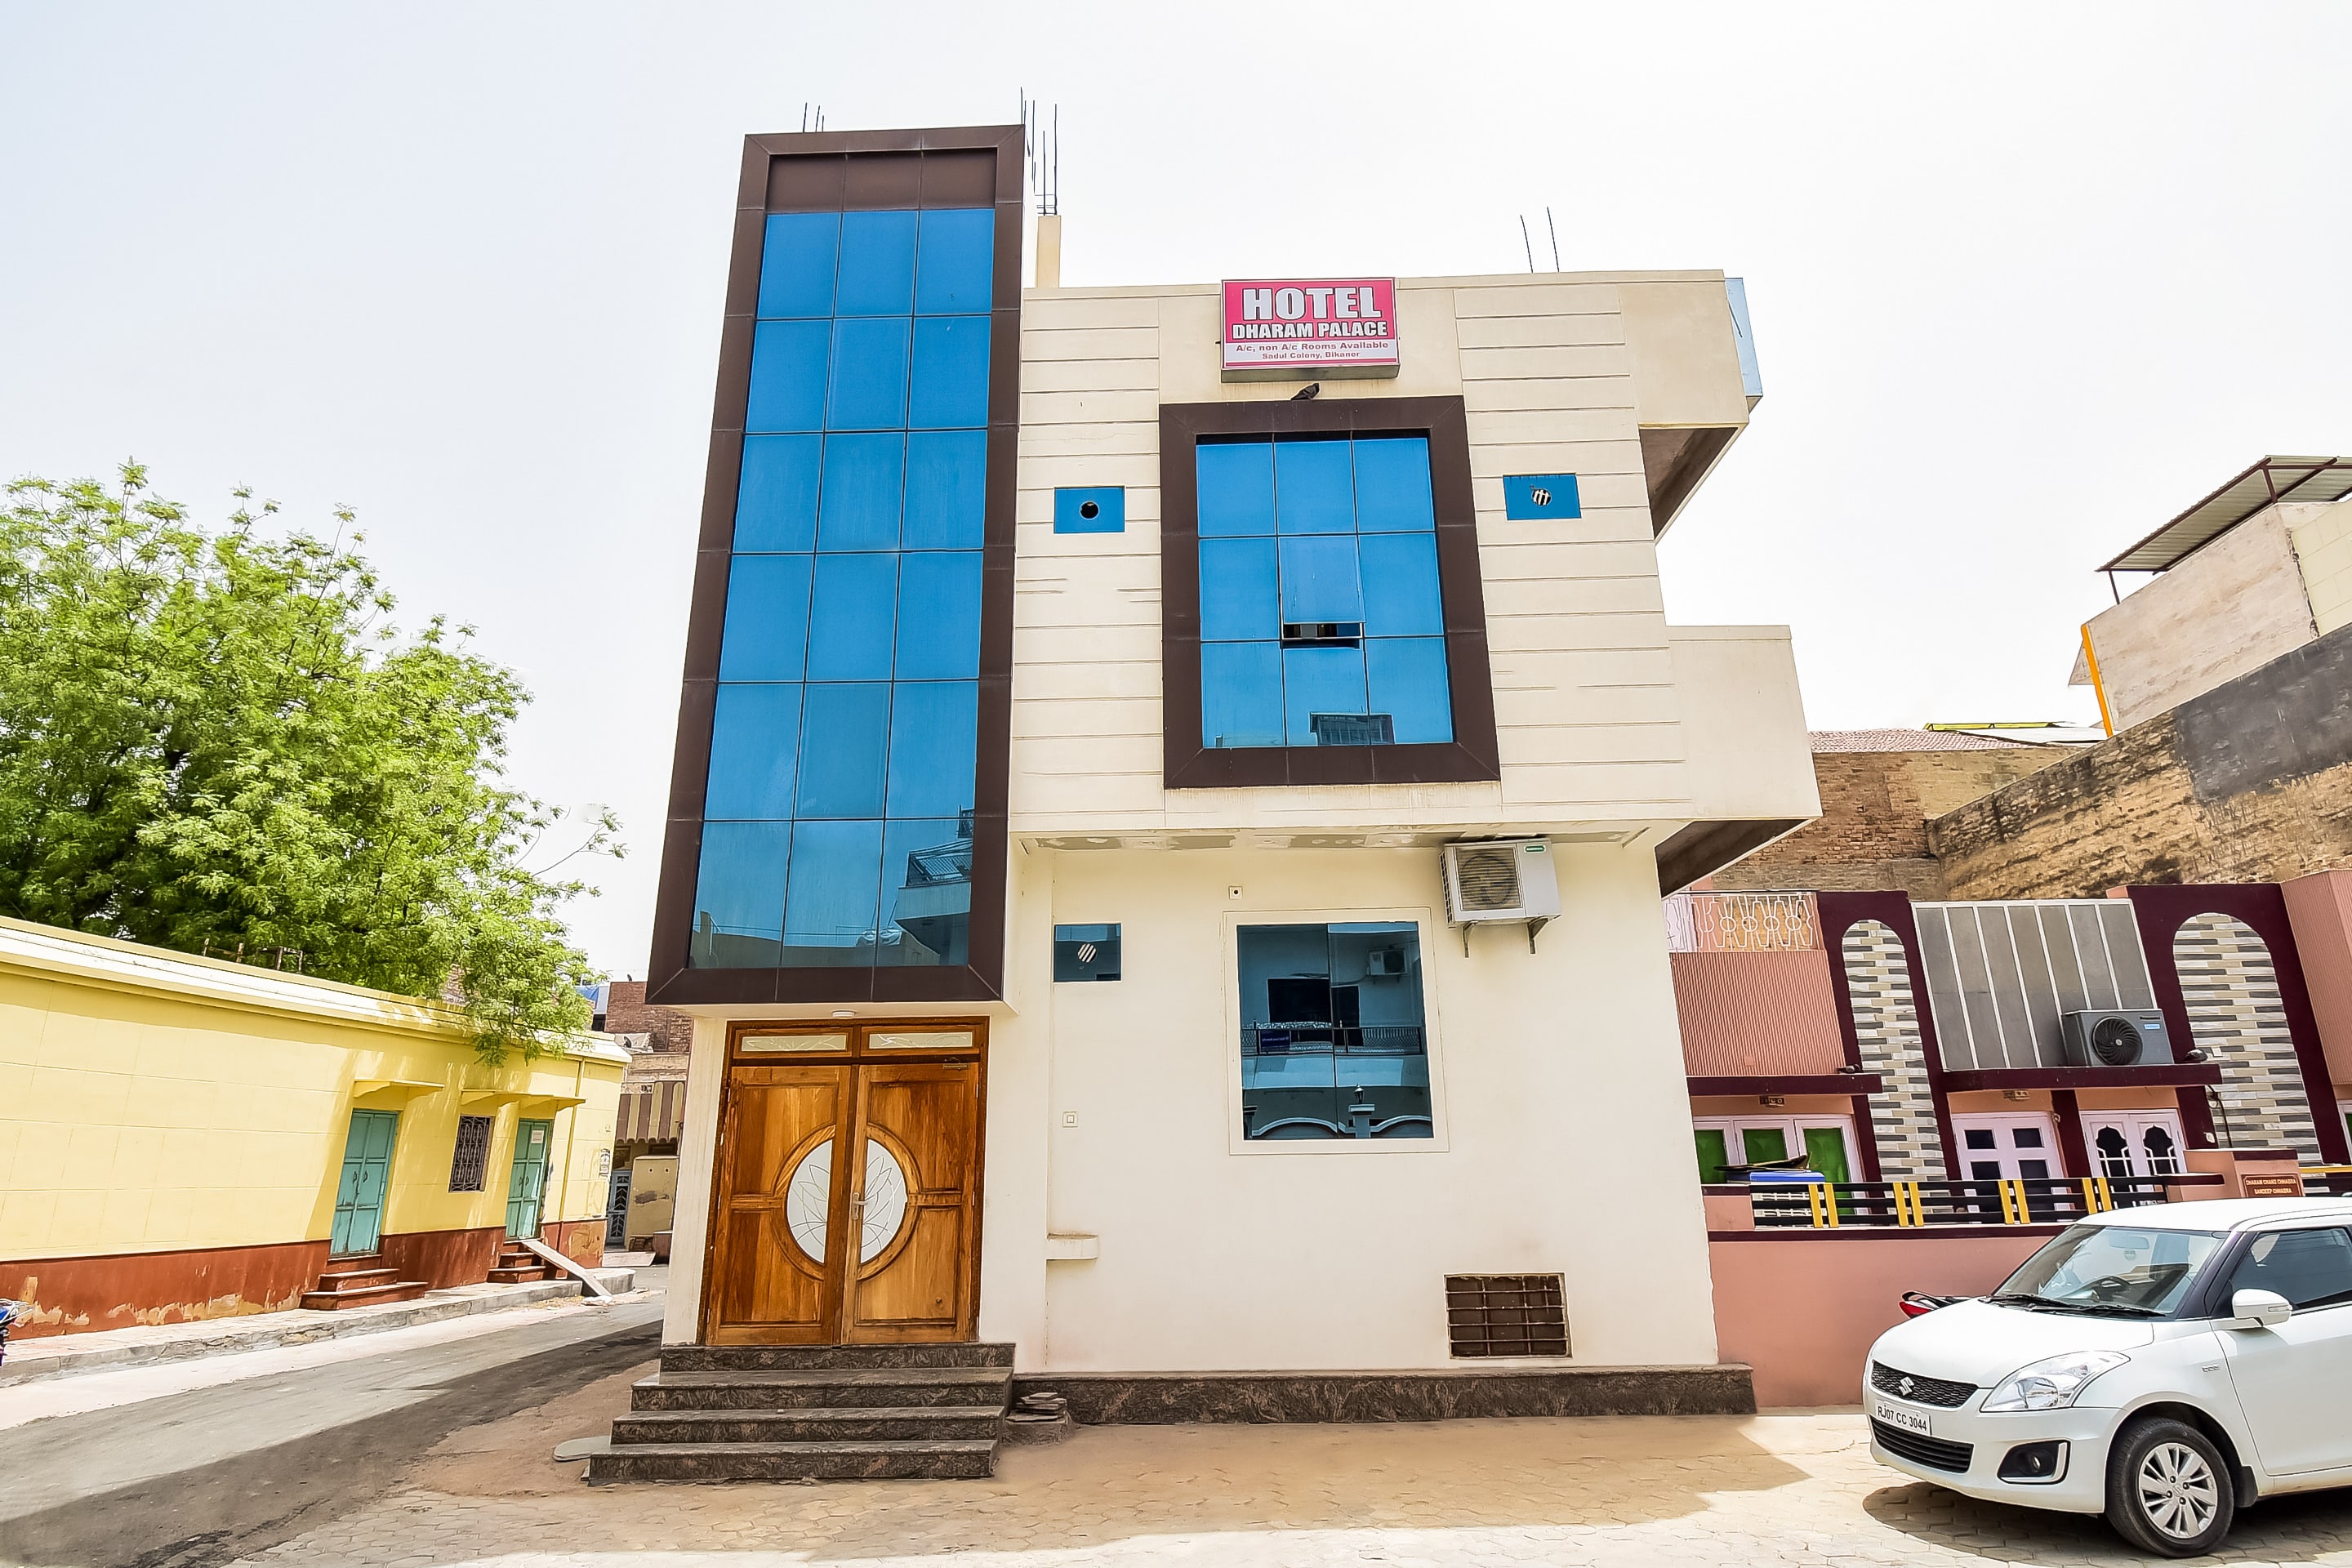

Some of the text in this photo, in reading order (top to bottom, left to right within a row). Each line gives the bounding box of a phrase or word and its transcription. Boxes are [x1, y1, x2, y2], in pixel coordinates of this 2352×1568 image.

[1242, 287, 1383, 320] HOTEL
[1232, 321, 1388, 339] DHARAM PALACE
[1878, 1405, 1927, 1432] RJ07 CC 3044
